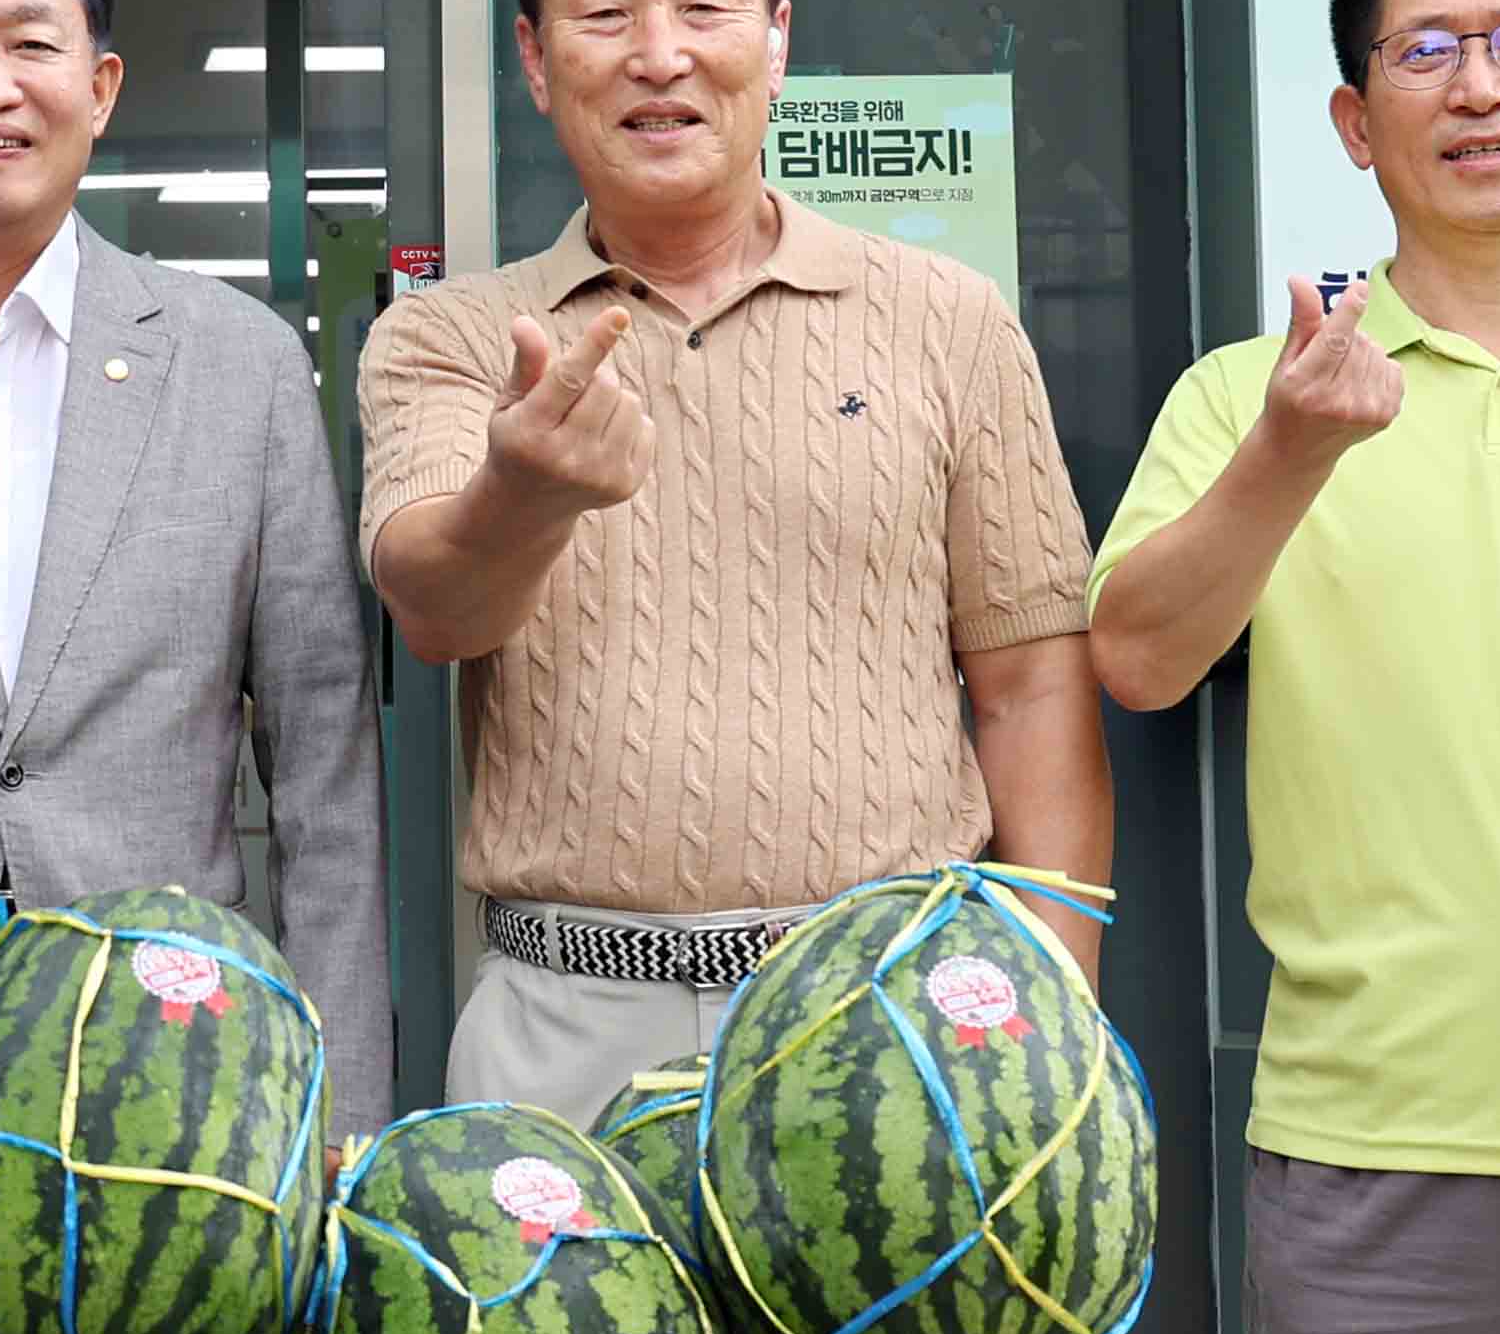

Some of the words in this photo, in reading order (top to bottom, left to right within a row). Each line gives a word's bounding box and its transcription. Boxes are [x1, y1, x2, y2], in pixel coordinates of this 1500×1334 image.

[863, 100, 904, 122] 위해
[777, 129, 973, 179] 담배금지!
[816, 188, 867, 204] 30m까지
